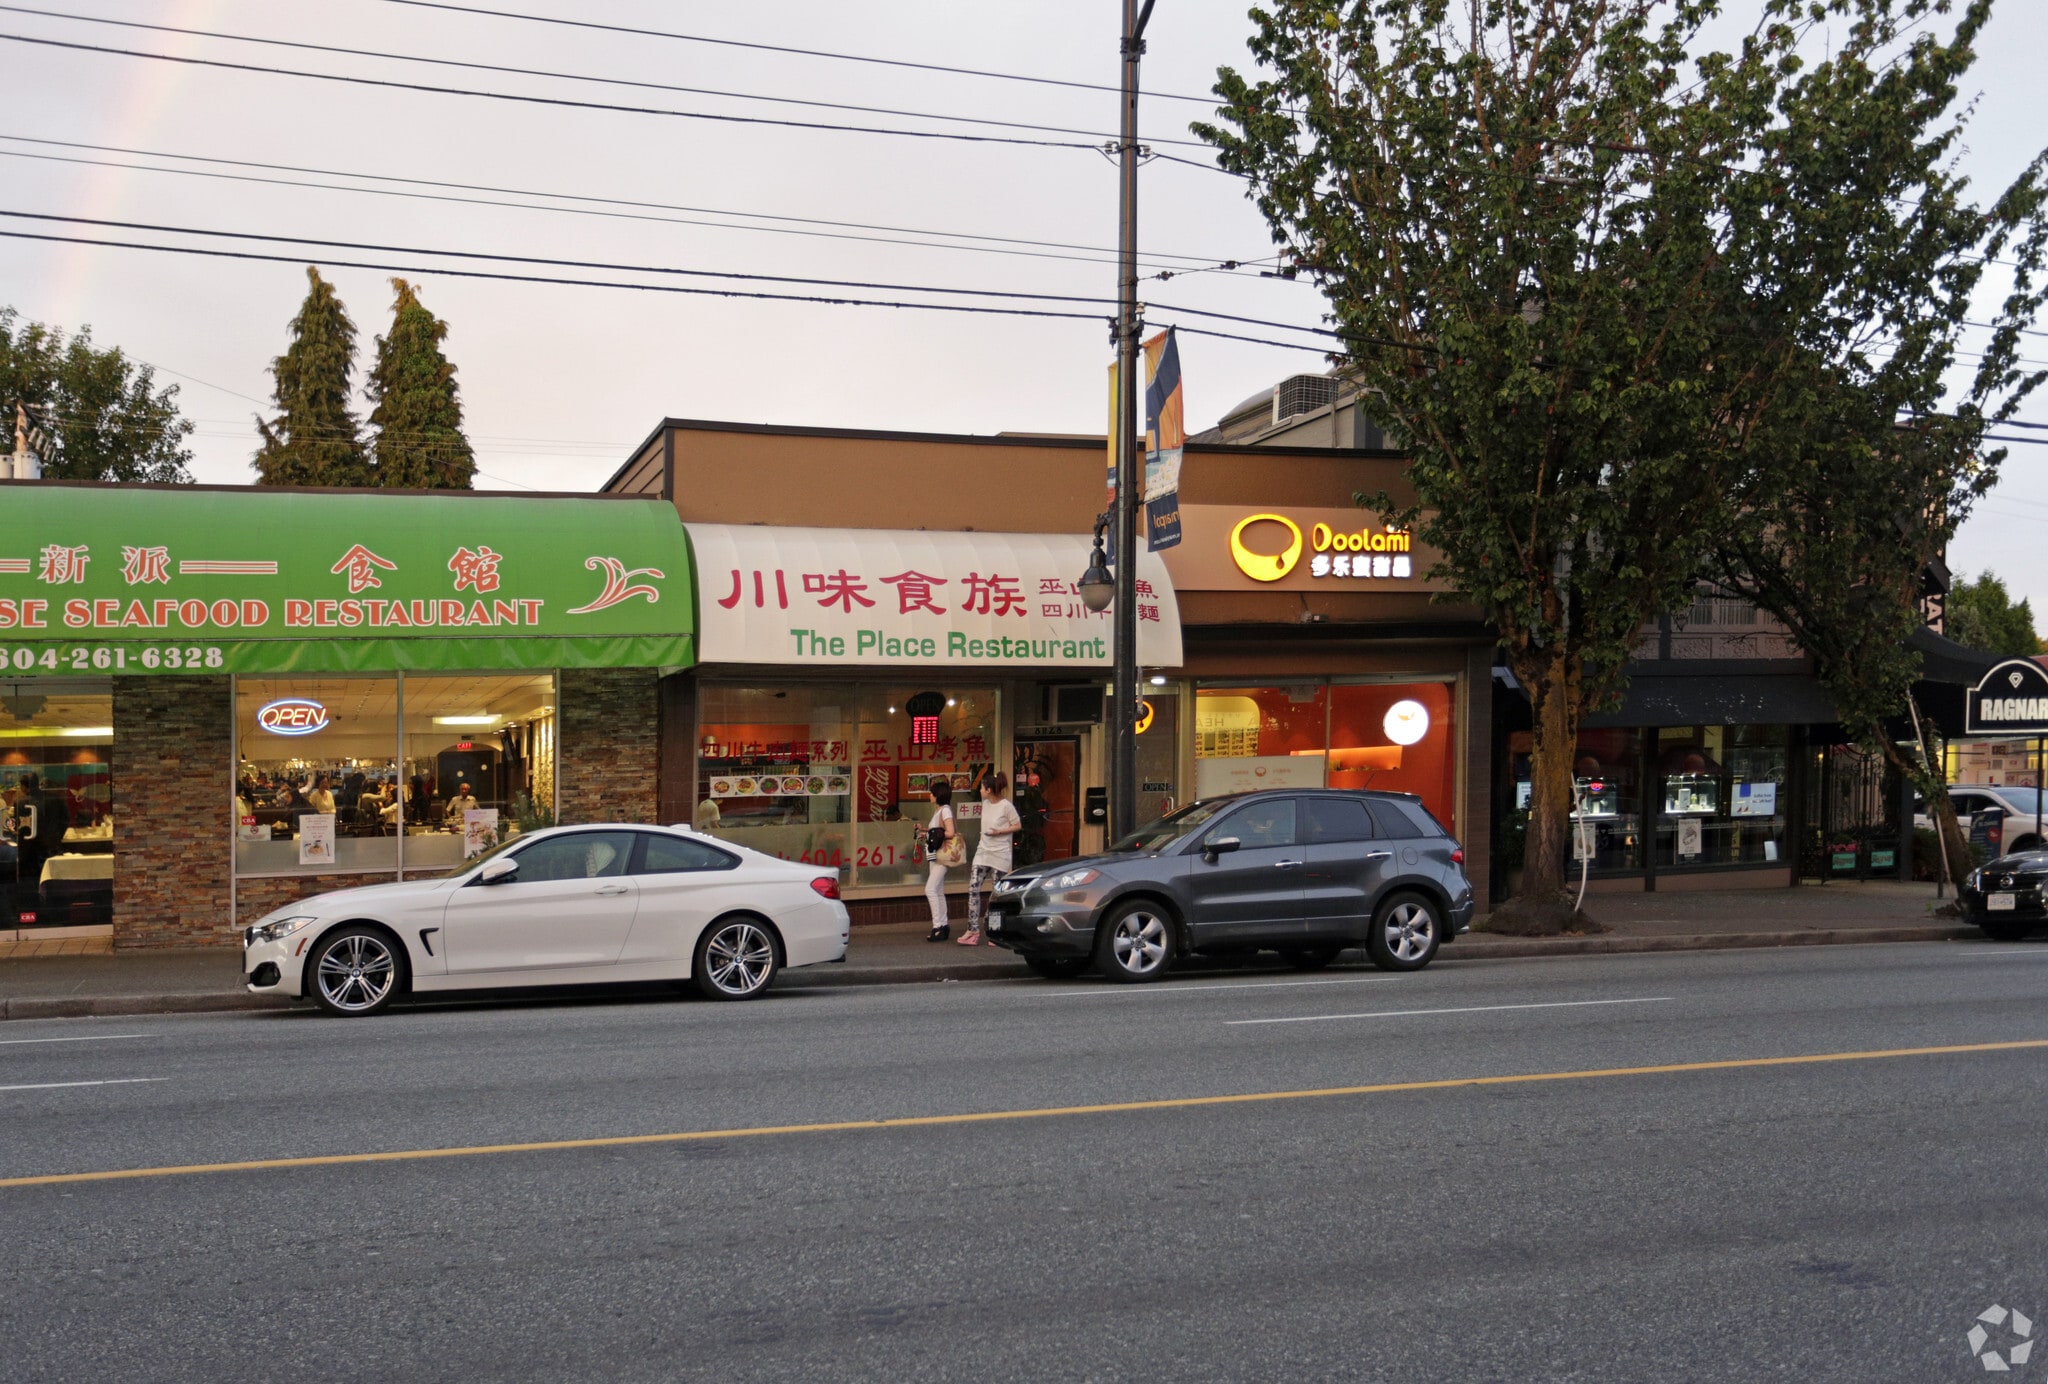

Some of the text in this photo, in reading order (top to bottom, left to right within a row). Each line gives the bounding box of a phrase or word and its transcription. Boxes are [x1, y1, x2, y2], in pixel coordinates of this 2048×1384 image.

[1312, 522, 1411, 552] Doolami
[717, 568, 1028, 618] 川味食族
[63, 598, 270, 629] SEAFOOD
[285, 598, 544, 629] RESTAURANT
[790, 629, 1106, 658] The Place Restaurant
[261, 708, 327, 726] OPEN
[1980, 698, 2048, 721] RAGNAR
